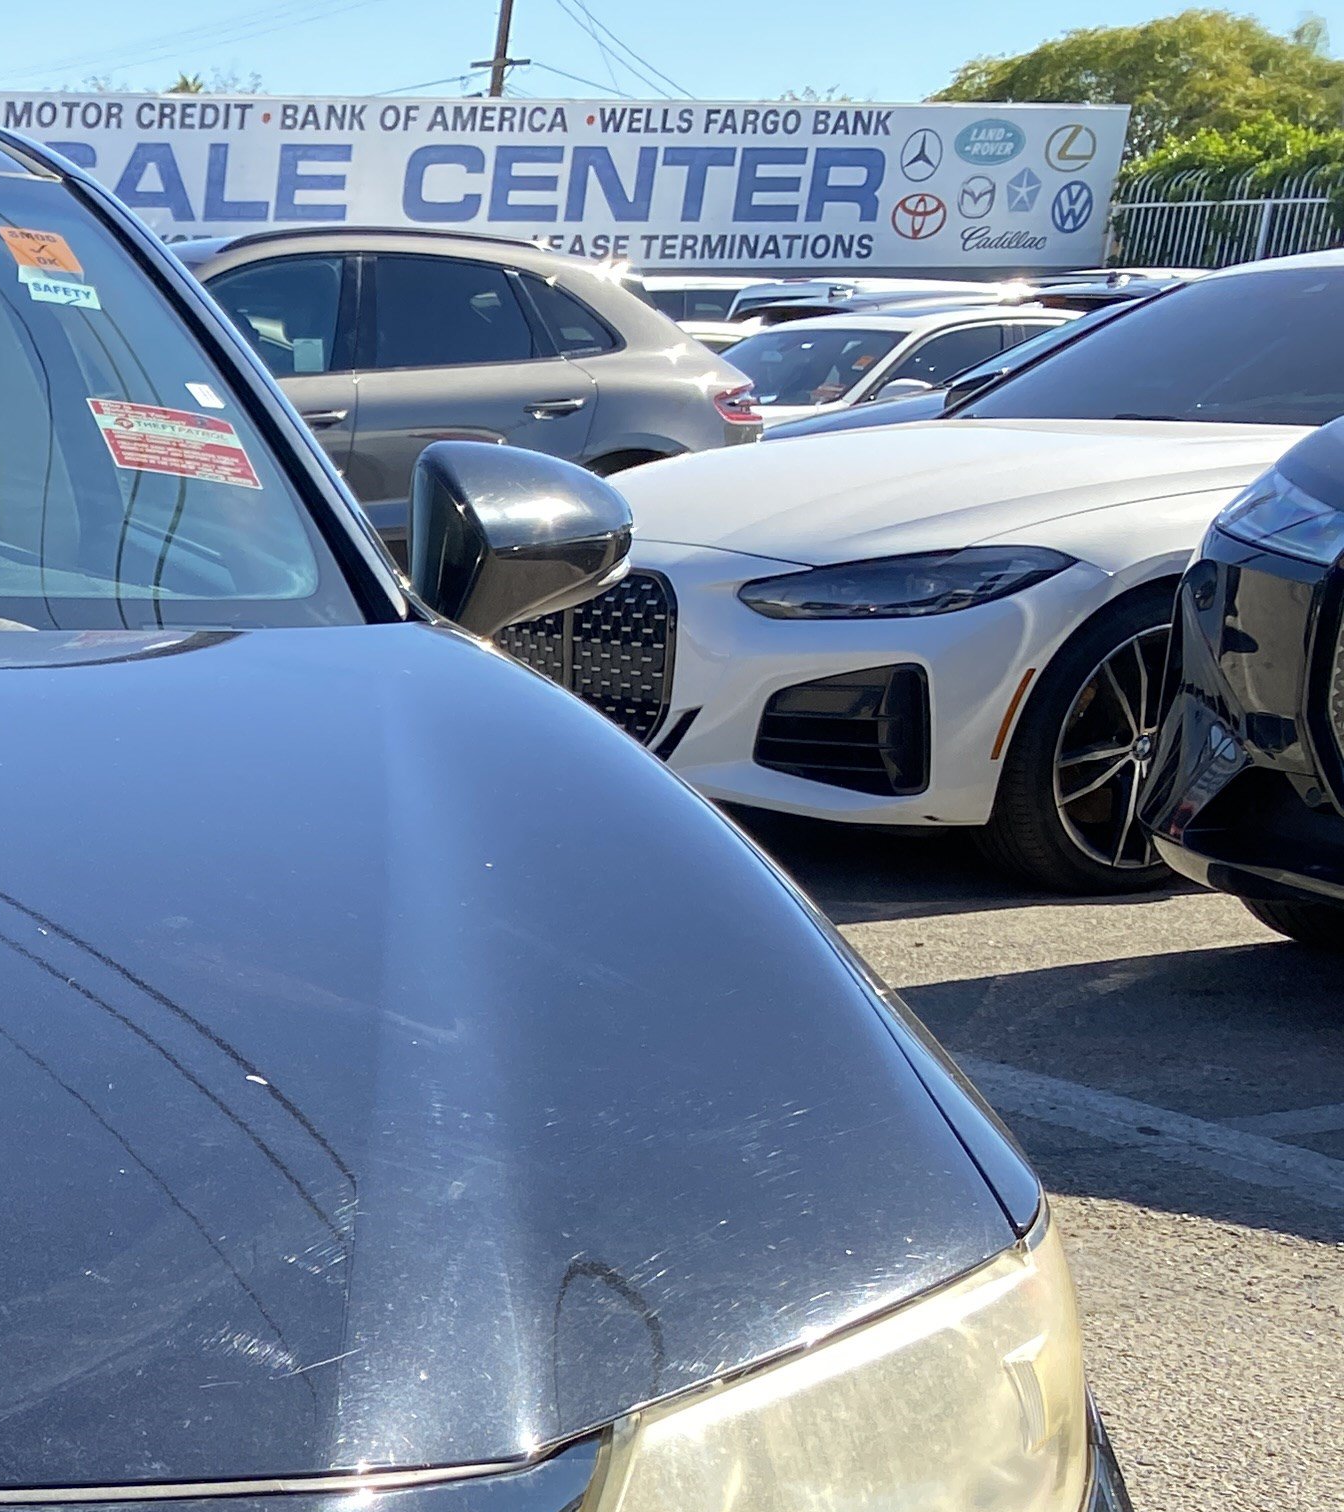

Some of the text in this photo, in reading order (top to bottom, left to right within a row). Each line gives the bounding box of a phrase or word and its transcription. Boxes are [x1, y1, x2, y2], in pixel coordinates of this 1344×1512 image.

[4, 101, 123, 130] MOTOR
[135, 103, 253, 130] CREDIT
[279, 104, 368, 131] BANK
[379, 105, 420, 132] OF
[426, 106, 569, 133] AMERICA
[599, 107, 694, 134] WELLS
[703, 109, 802, 135] FARGO
[812, 110, 895, 136] BANK
[970, 128, 1006, 142] LAND
[45, 141, 886, 222] ALE CENTER
[532, 234, 874, 260] EASE TERMINATIONS
[960, 225, 1048, 252] Cadillac
[32, 282, 91, 300] SAFETY
